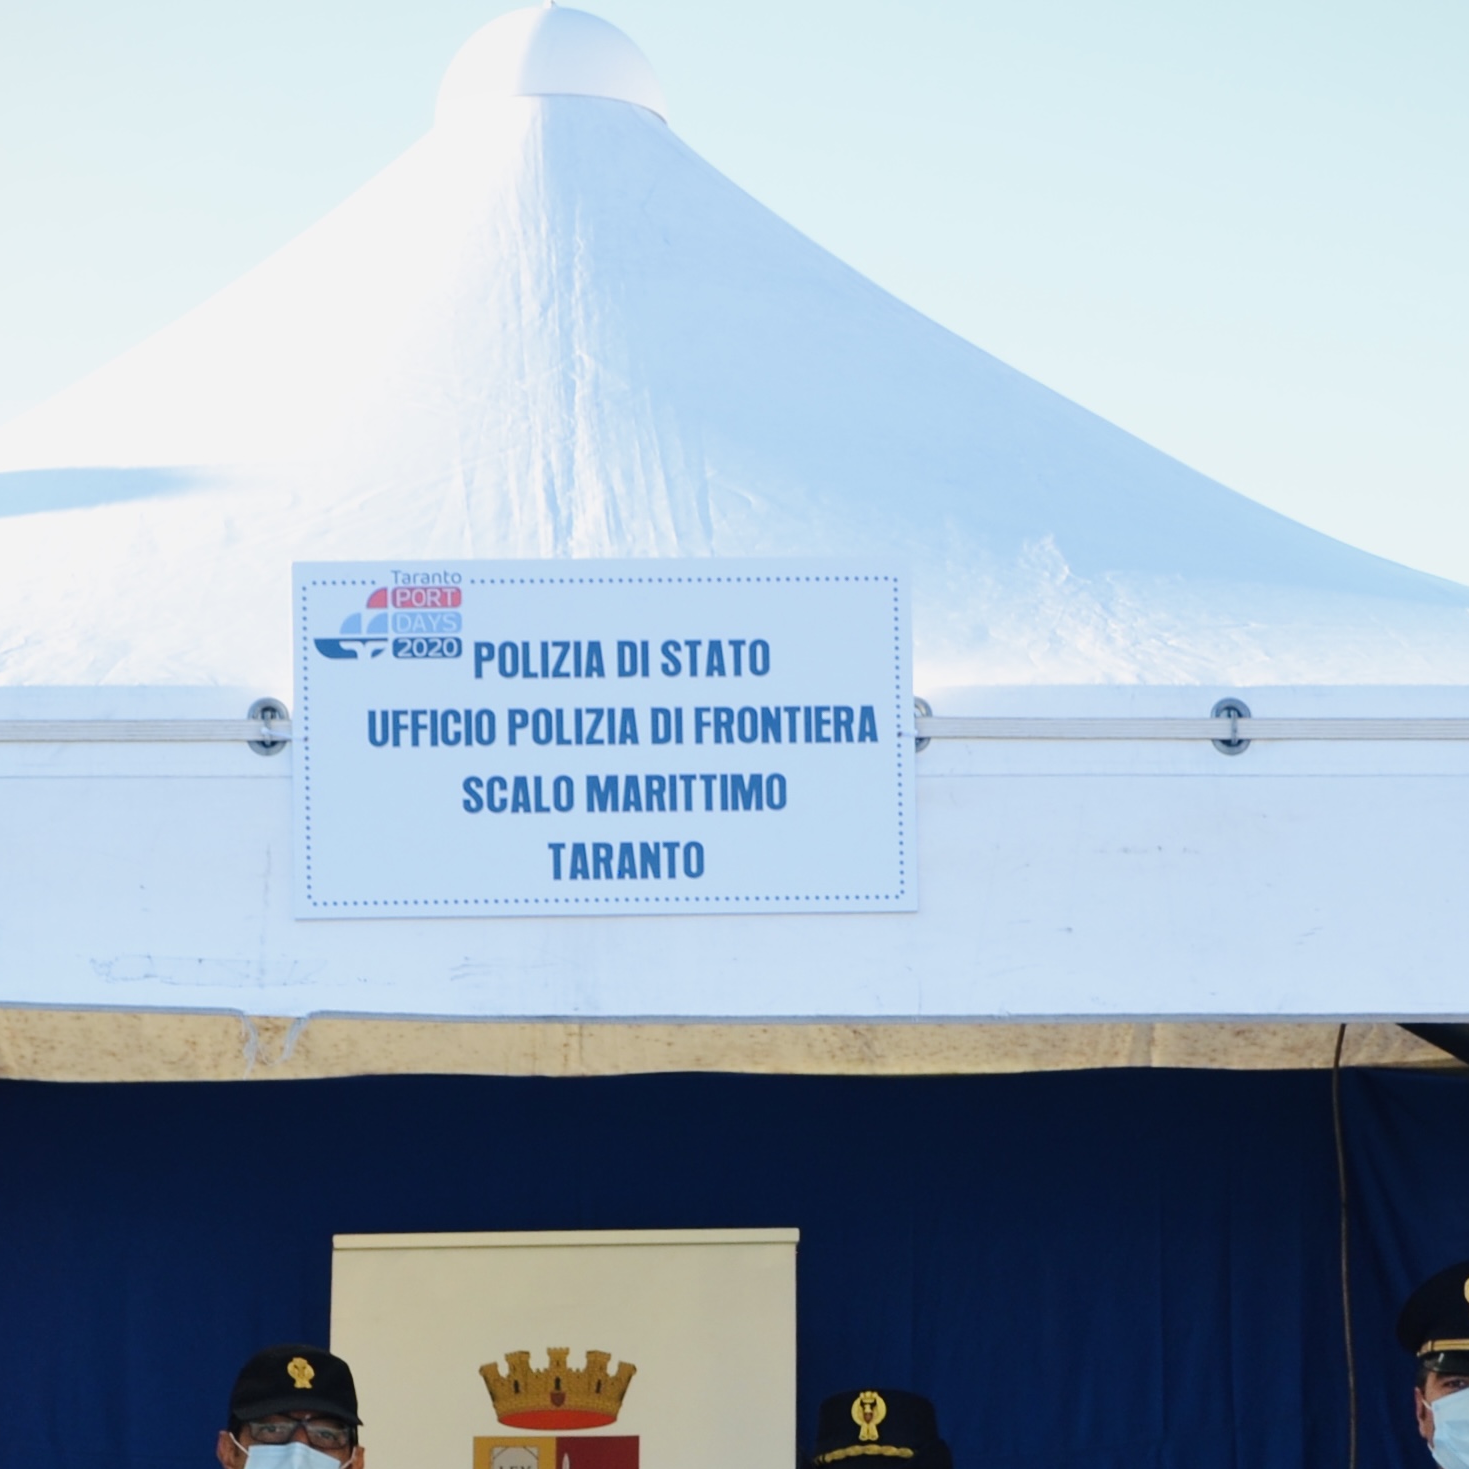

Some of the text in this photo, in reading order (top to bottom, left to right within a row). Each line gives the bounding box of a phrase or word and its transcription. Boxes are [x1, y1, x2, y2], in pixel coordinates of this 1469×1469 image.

[390, 570, 462, 585] Taranto
[395, 588, 456, 607] PORT
[396, 613, 457, 632] DAYS
[397, 638, 458, 657] 2020
[474, 639, 770, 679] POLIZIA DI STATO
[367, 705, 879, 747] UFFICIO POLIZIA DI FRONTIERA
[462, 772, 787, 814] SCALO MARITTIMO
[547, 840, 705, 880] TARANTO
